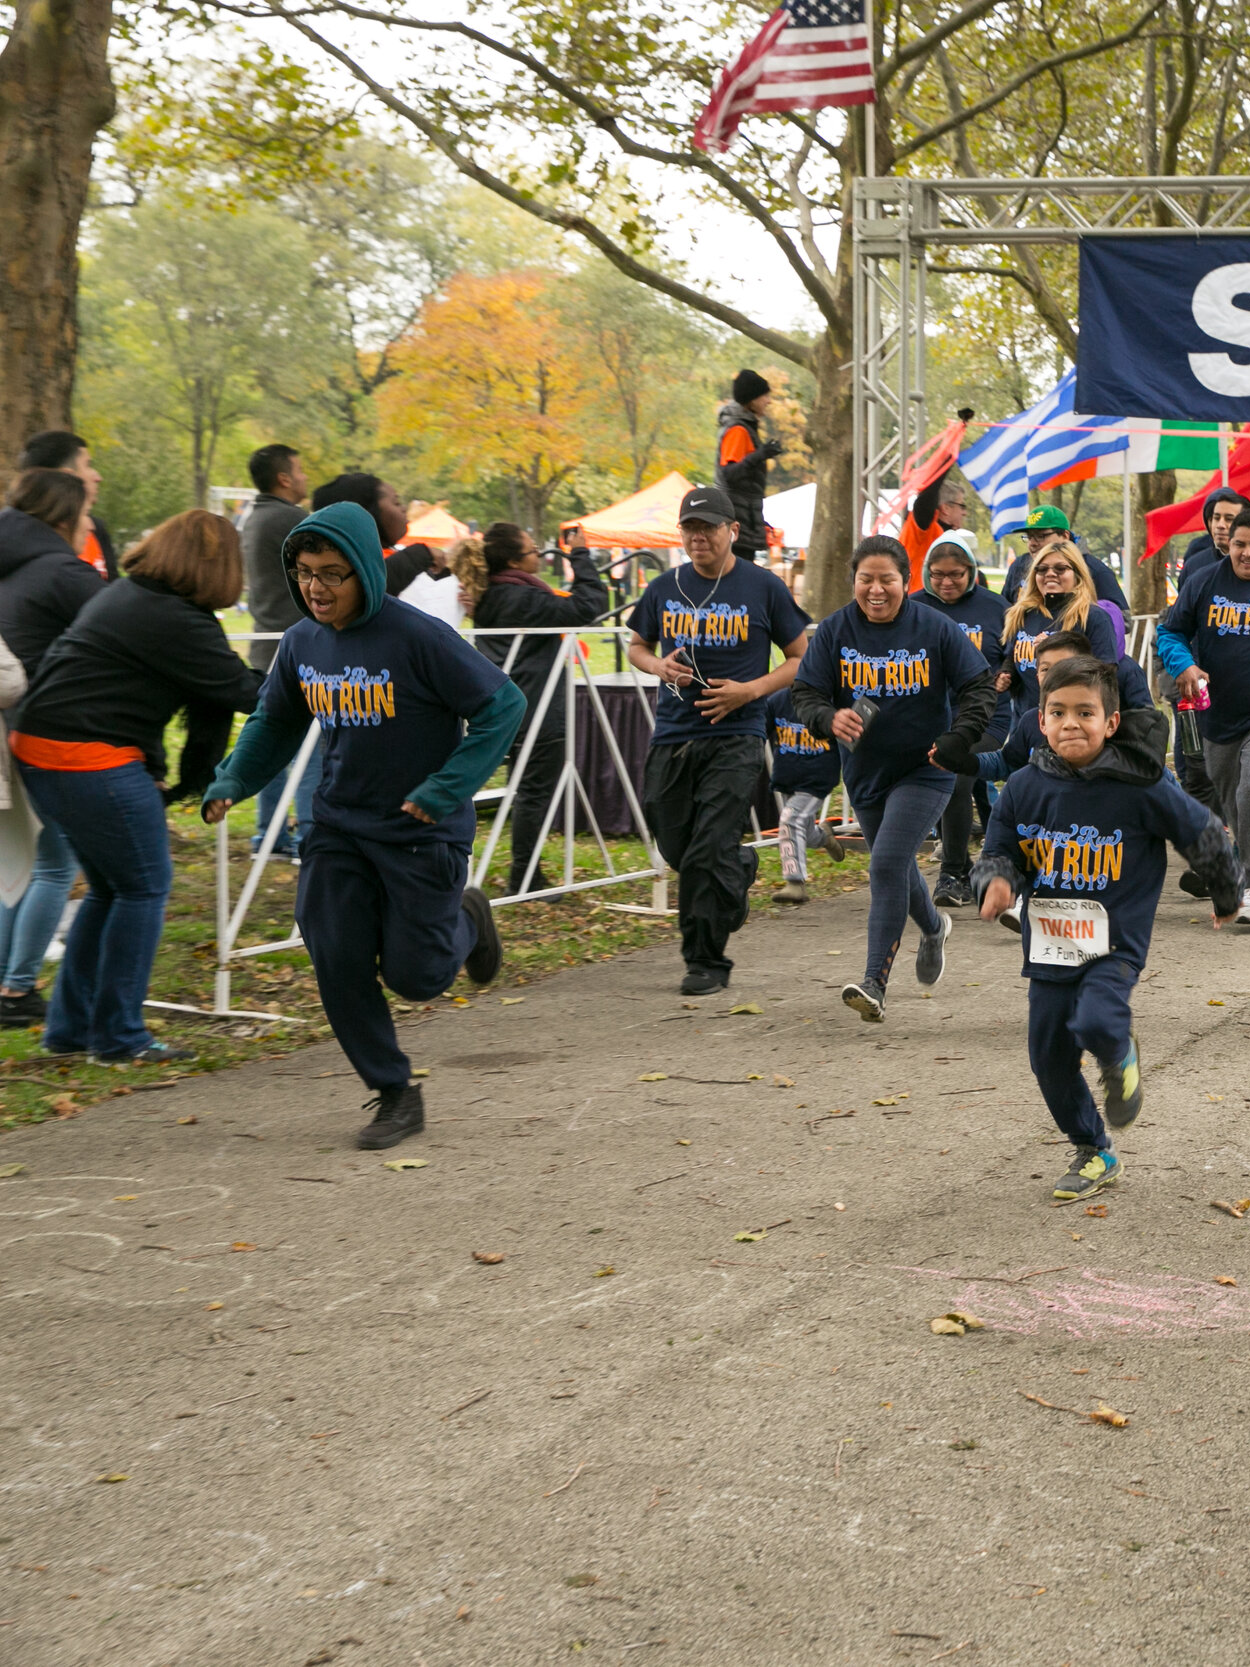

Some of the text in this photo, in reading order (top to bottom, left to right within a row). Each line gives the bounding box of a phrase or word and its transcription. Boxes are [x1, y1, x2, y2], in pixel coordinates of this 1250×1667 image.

[662, 611, 749, 642] FUN RUN
[1207, 604, 1241, 629] FUN
[703, 634, 738, 648] 2019
[840, 658, 930, 690] FUN RUN
[339, 680, 396, 719] RUN
[884, 682, 921, 697] 2019
[339, 710, 382, 727] 2019
[1016, 823, 1123, 852] Chicago Run
[1062, 840, 1124, 883] RUN
[1060, 871, 1109, 892] 2019
[1032, 899, 1103, 911] CHICAGO RUN
[1038, 917, 1095, 939] TWAIN
[1056, 947, 1076, 961] Fun
